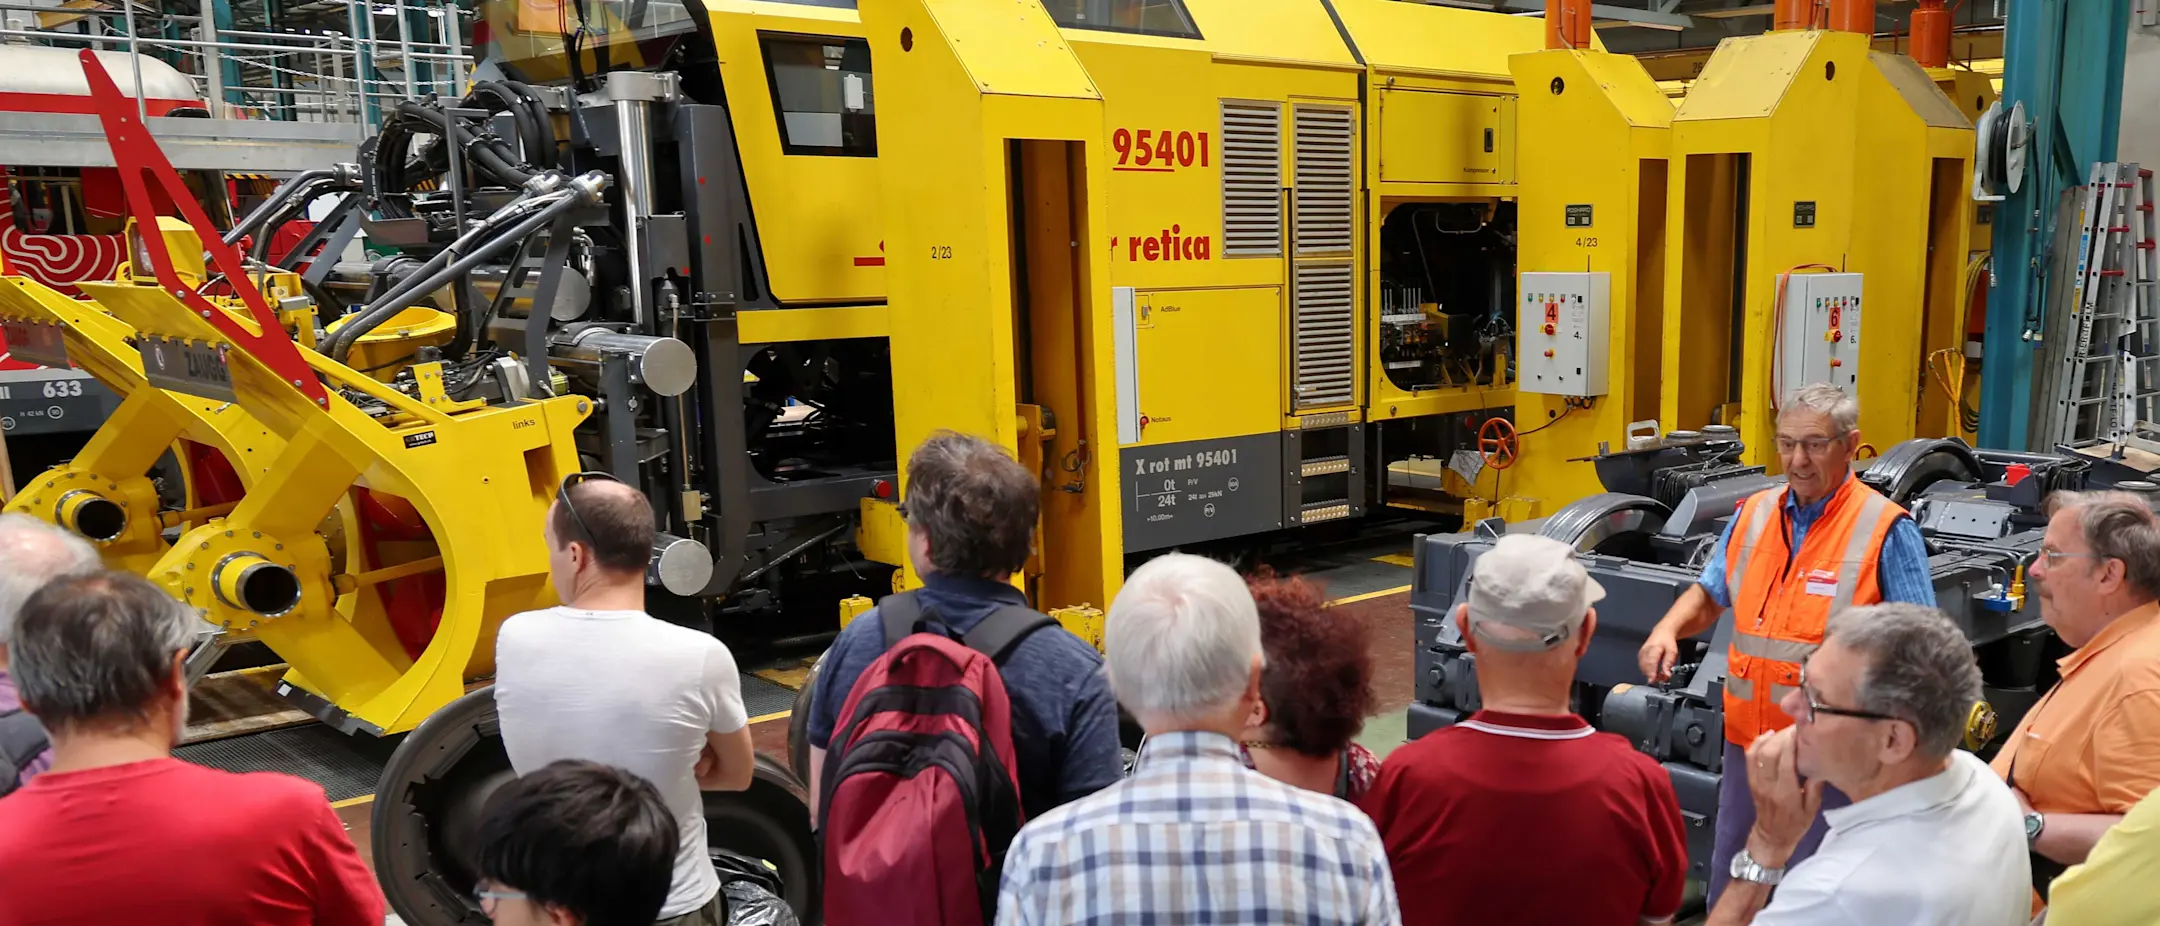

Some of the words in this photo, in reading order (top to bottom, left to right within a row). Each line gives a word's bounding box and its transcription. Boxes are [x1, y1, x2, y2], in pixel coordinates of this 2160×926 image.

[1112, 128, 1209, 168] 95401
[1129, 224, 1211, 262] retica
[1575, 236, 1598, 248] 4/23
[931, 246, 952, 260] 2/23
[1546, 304, 1557, 321] 4
[1831, 310, 1838, 327] 6
[42, 380, 83, 399] 633
[512, 419, 536, 430] links
[1135, 459, 1146, 475] X
[1149, 457, 1170, 474] rot
[1174, 455, 1193, 471] mt
[1196, 448, 1237, 468] 95401
[1163, 479, 1176, 491] 0t
[1158, 494, 1177, 507] 24t
